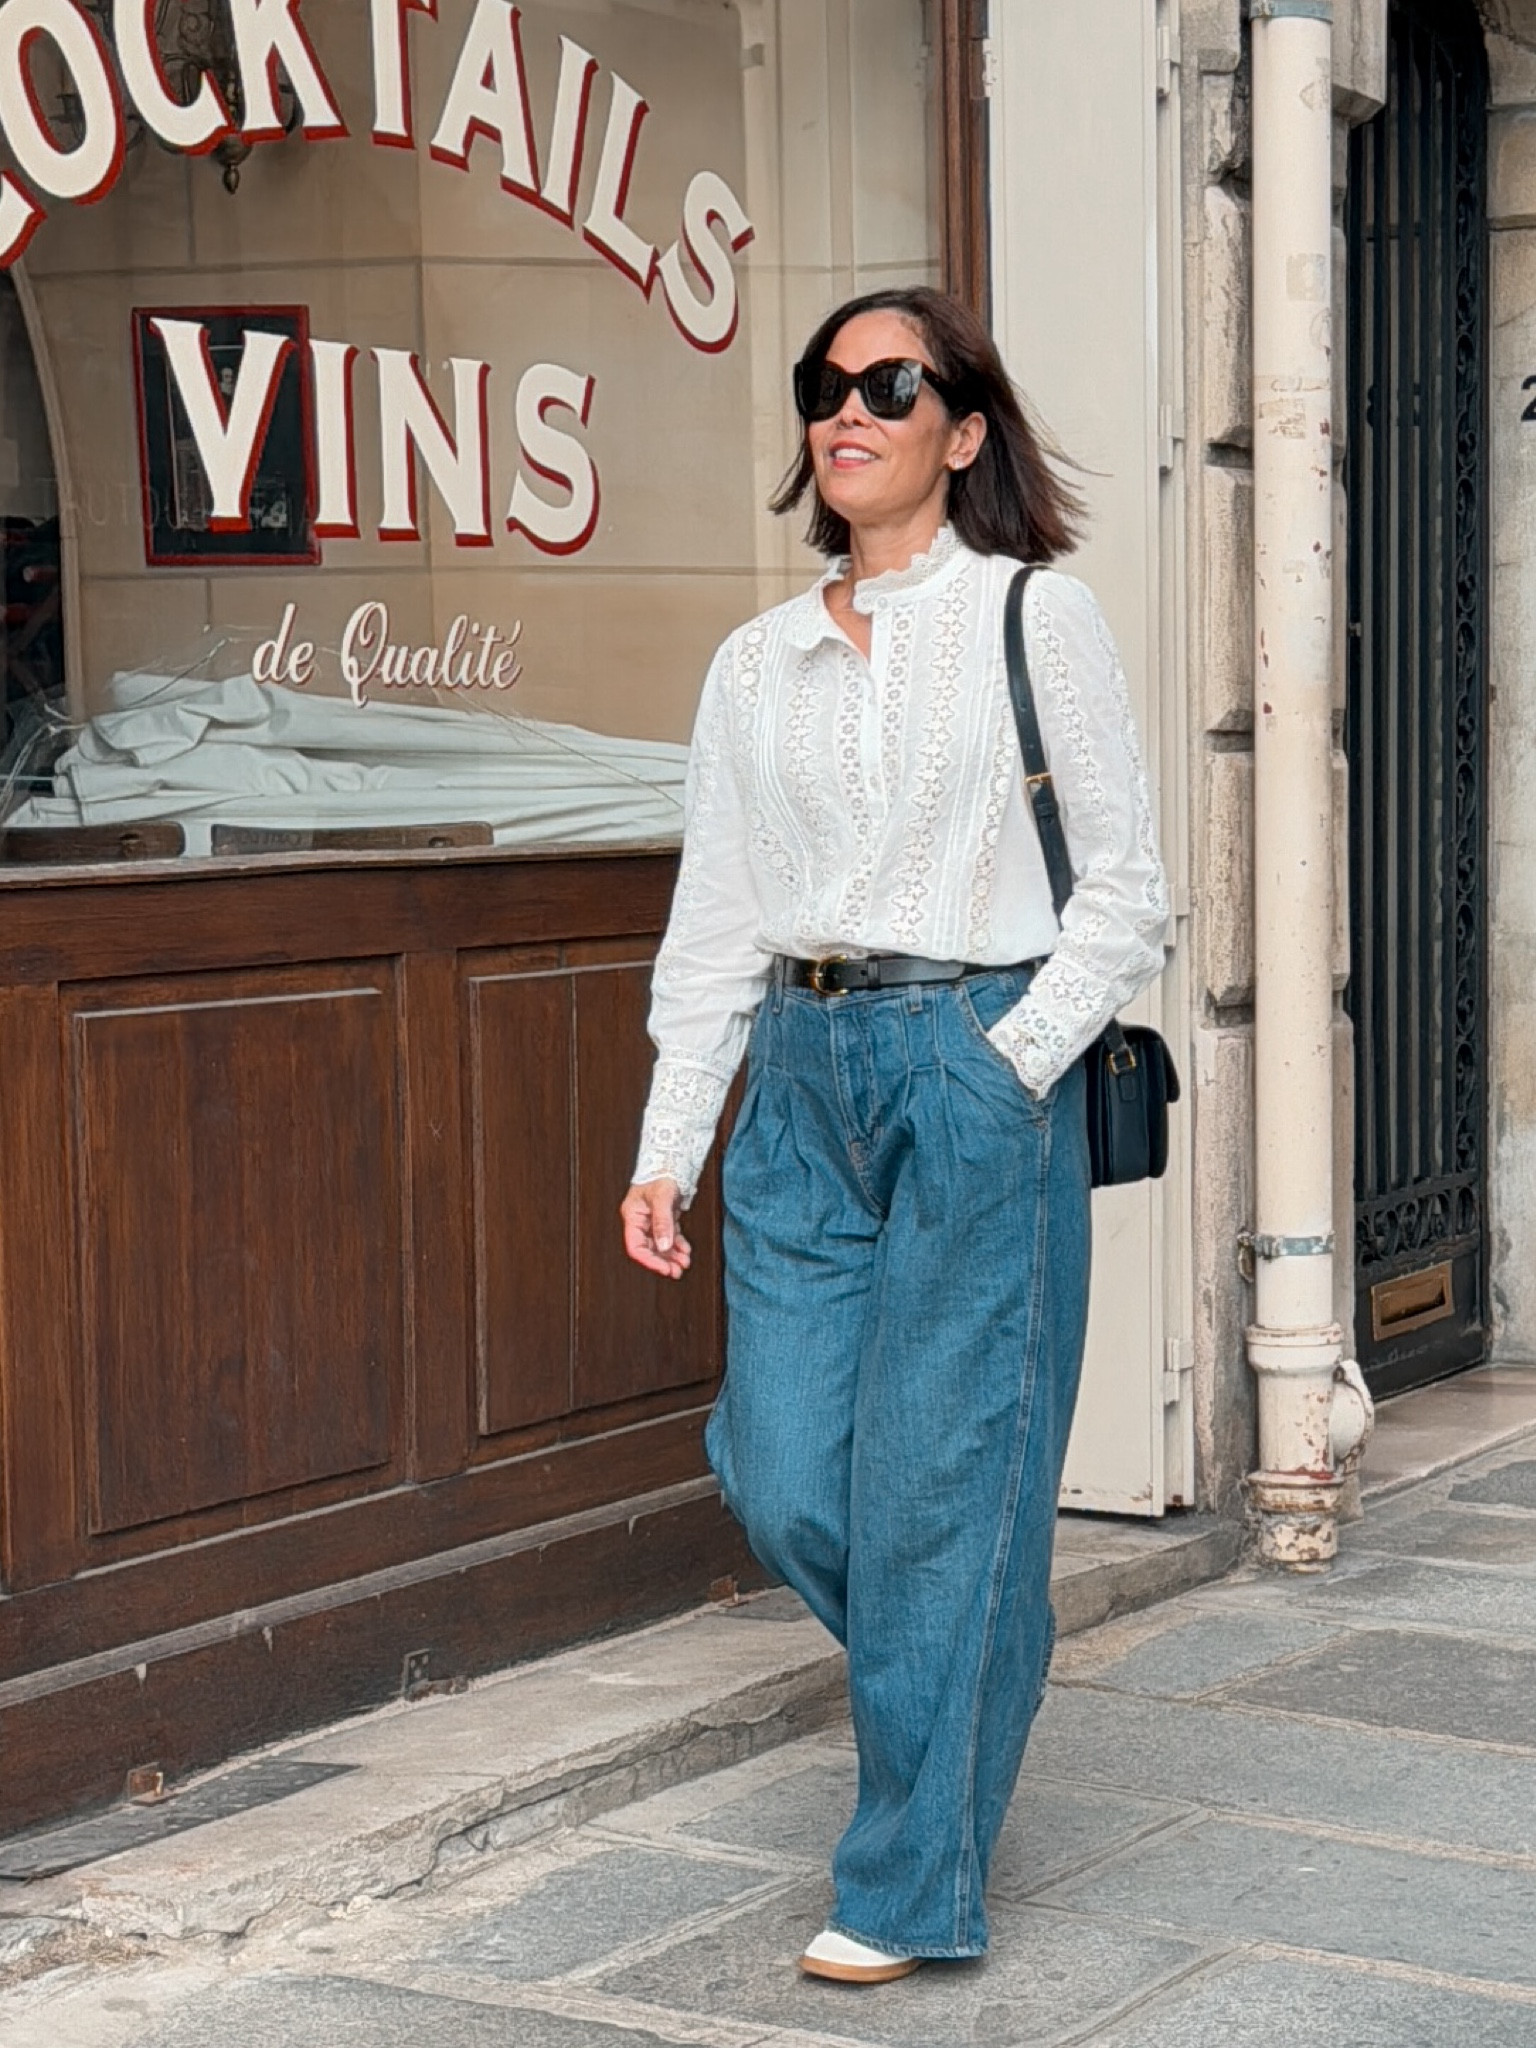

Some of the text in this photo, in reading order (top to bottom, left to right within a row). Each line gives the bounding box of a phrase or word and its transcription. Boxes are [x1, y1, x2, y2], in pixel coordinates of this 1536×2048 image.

[0, 0, 755, 354] OCKTAILS
[149, 317, 600, 556] VINS
[252, 601, 524, 708] de Qualité
